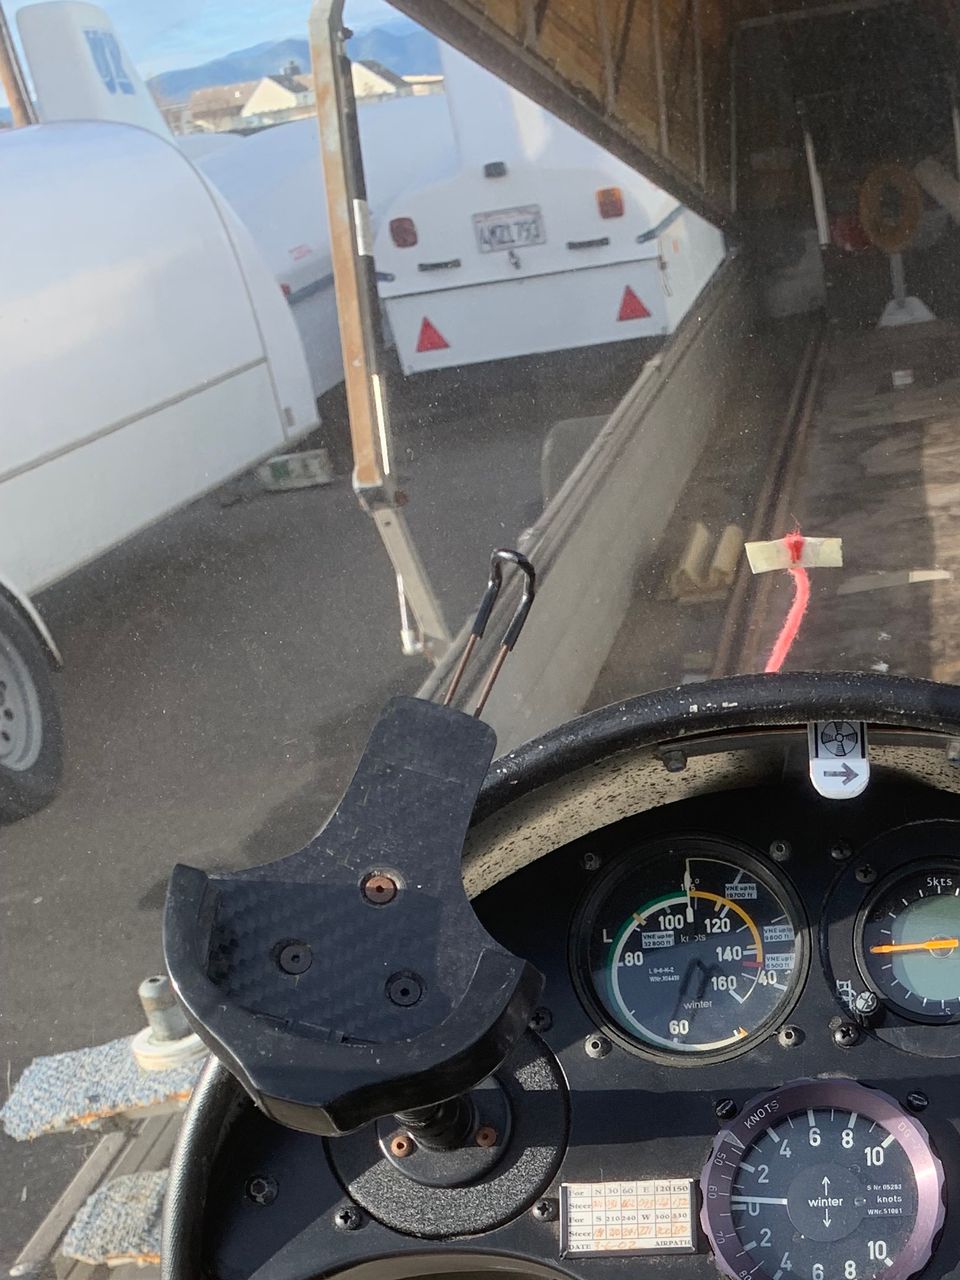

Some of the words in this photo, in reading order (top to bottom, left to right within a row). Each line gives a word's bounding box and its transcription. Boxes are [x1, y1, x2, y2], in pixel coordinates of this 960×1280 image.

[658, 914, 684, 930] 100
[704, 917, 731, 933] 120
[624, 951, 644, 967] 80
[716, 946, 742, 961] 140
[711, 975, 737, 991] 160
[758, 971, 777, 985] 40
[683, 1000, 712, 1010] winter
[669, 1019, 689, 1035] 60
[743, 1100, 780, 1130] KNOTS
[808, 1128, 821, 1147] 6
[841, 1129, 854, 1149] 8
[779, 1139, 792, 1158] 4
[864, 1146, 884, 1167] 10
[714, 1151, 727, 1166] 50
[757, 1165, 769, 1184] 2
[708, 1185, 717, 1199] 60
[876, 1195, 903, 1204] knots
[568, 1202, 592, 1210] Steer
[748, 1202, 760, 1216] 0
[808, 1197, 844, 1208] winter
[568, 1216, 584, 1224] For
[621, 1214, 637, 1222] 240
[568, 1230, 592, 1238] Steer
[759, 1228, 772, 1247] 2
[867, 1240, 887, 1260] 10
[780, 1252, 793, 1271] 4
[844, 1260, 857, 1280] 8
